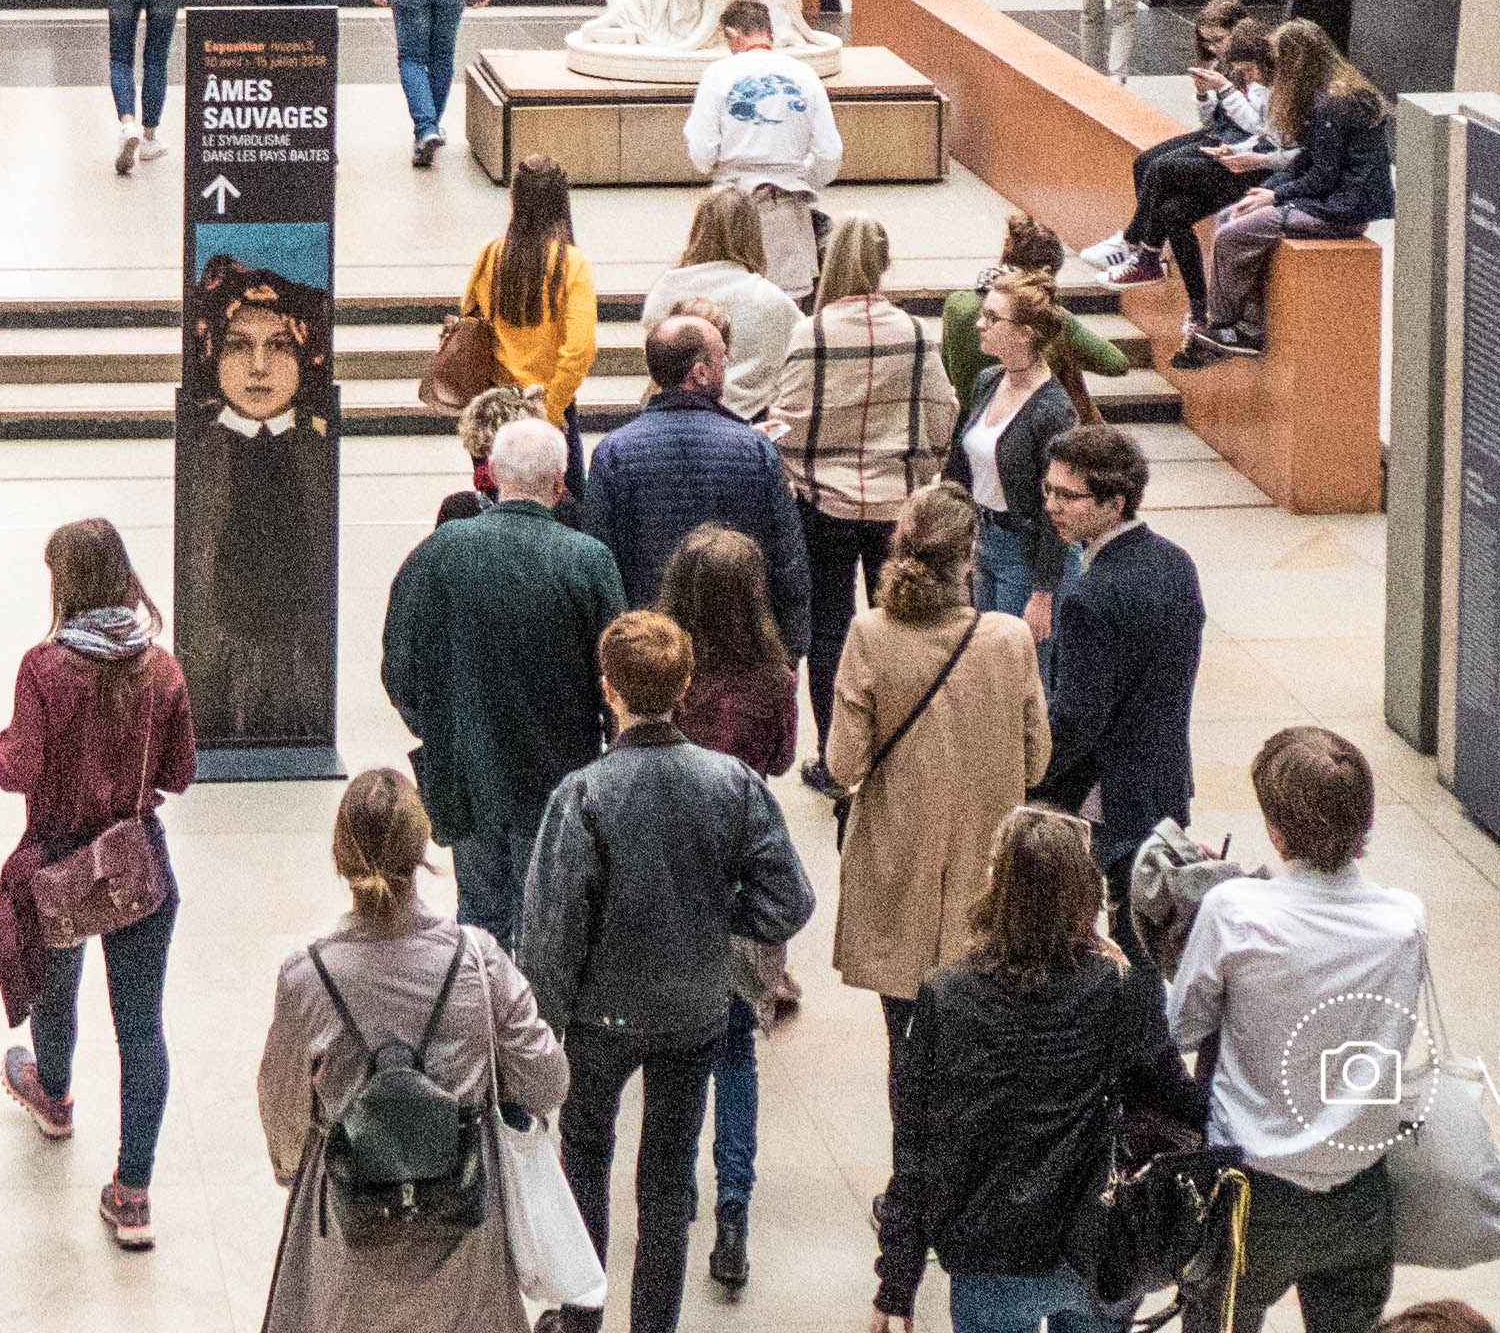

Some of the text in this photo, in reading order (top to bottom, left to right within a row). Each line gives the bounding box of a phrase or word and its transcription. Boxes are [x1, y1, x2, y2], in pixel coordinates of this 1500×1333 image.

[204, 40, 265, 54] Exposition
[203, 74, 273, 102] ÂMES
[203, 106, 328, 129] SAUVAGES
[202, 134, 291, 147] LE SYMBOLISME
[202, 149, 330, 162] DANS LES PAYS BALTES
